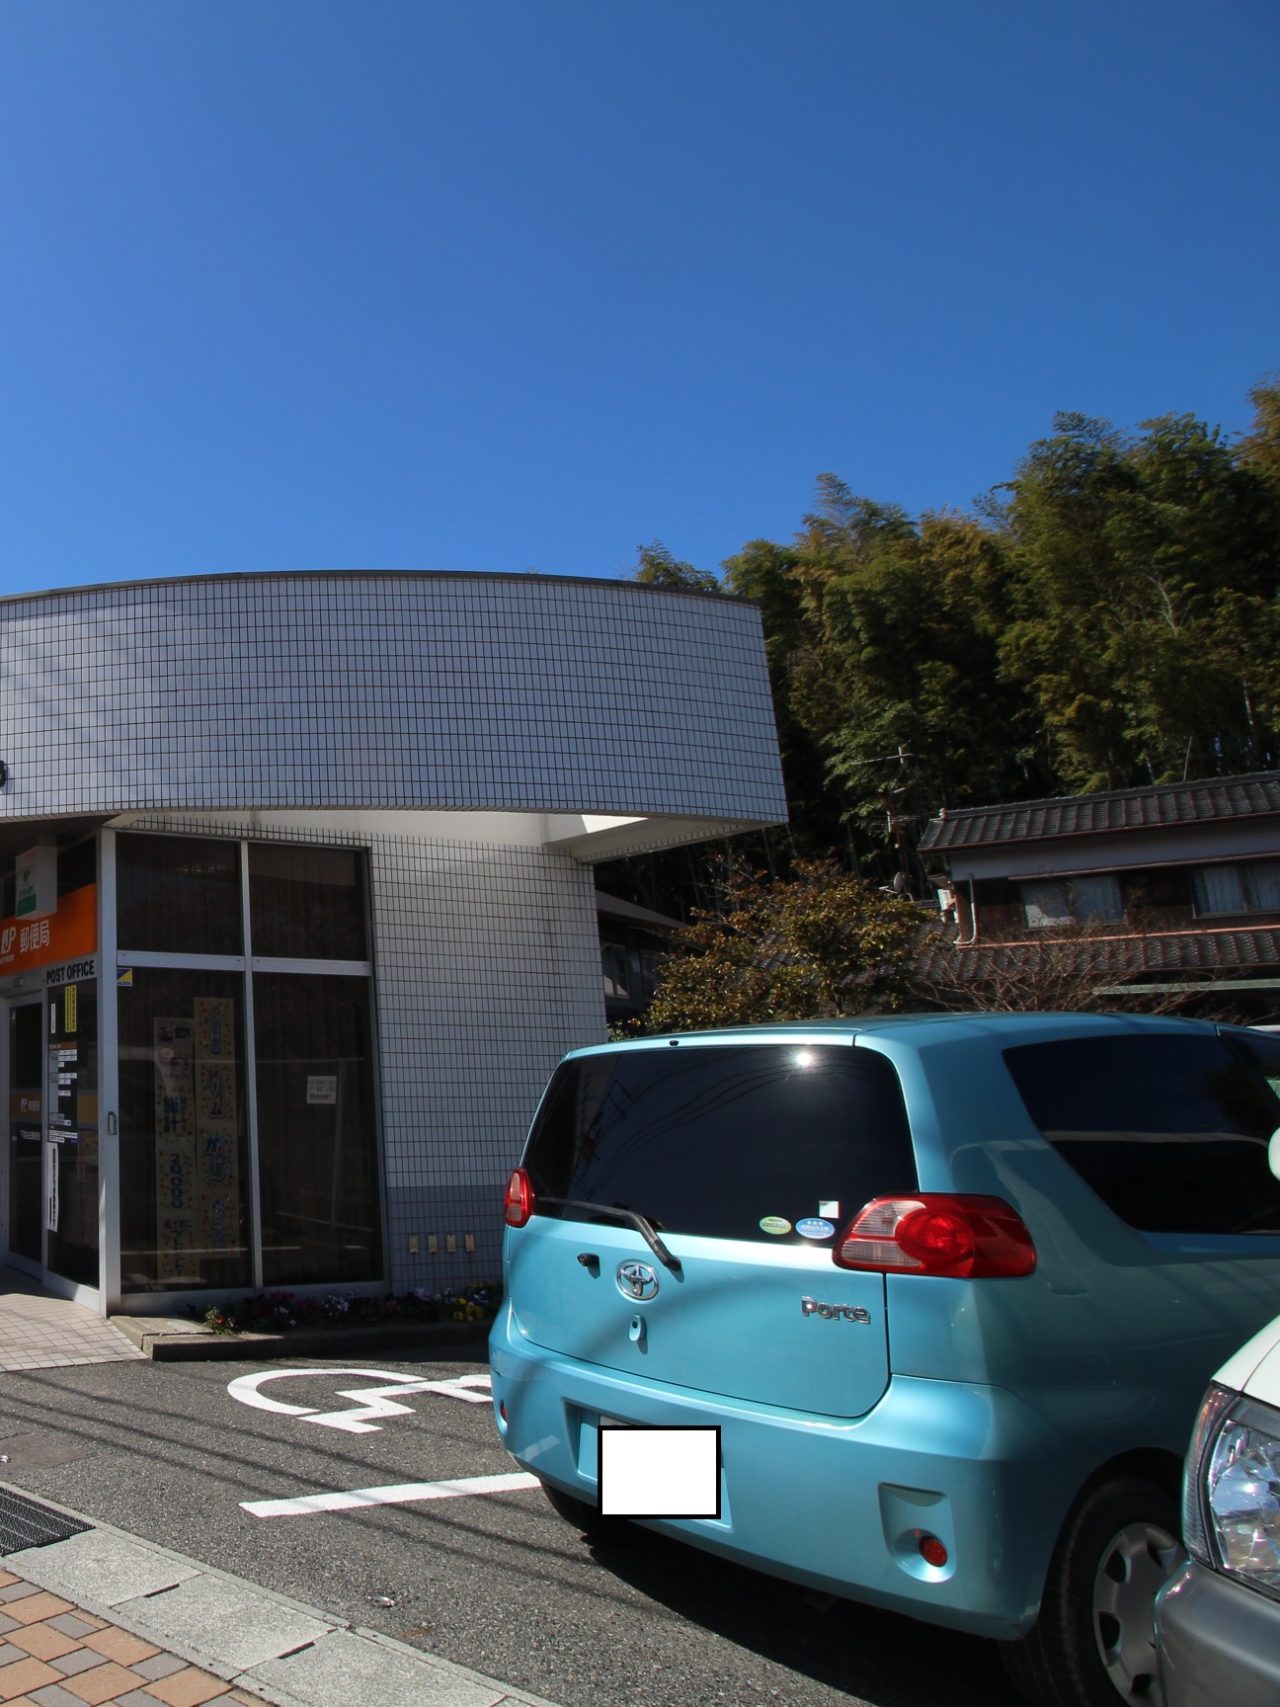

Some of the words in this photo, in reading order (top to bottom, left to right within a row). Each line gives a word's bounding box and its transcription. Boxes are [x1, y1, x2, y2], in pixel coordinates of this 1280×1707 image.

[19, 920, 50, 953] 郵便局
[46, 968, 65, 984] POST
[66, 960, 95, 980] OFFICE
[801, 1296, 870, 1325] Porte
